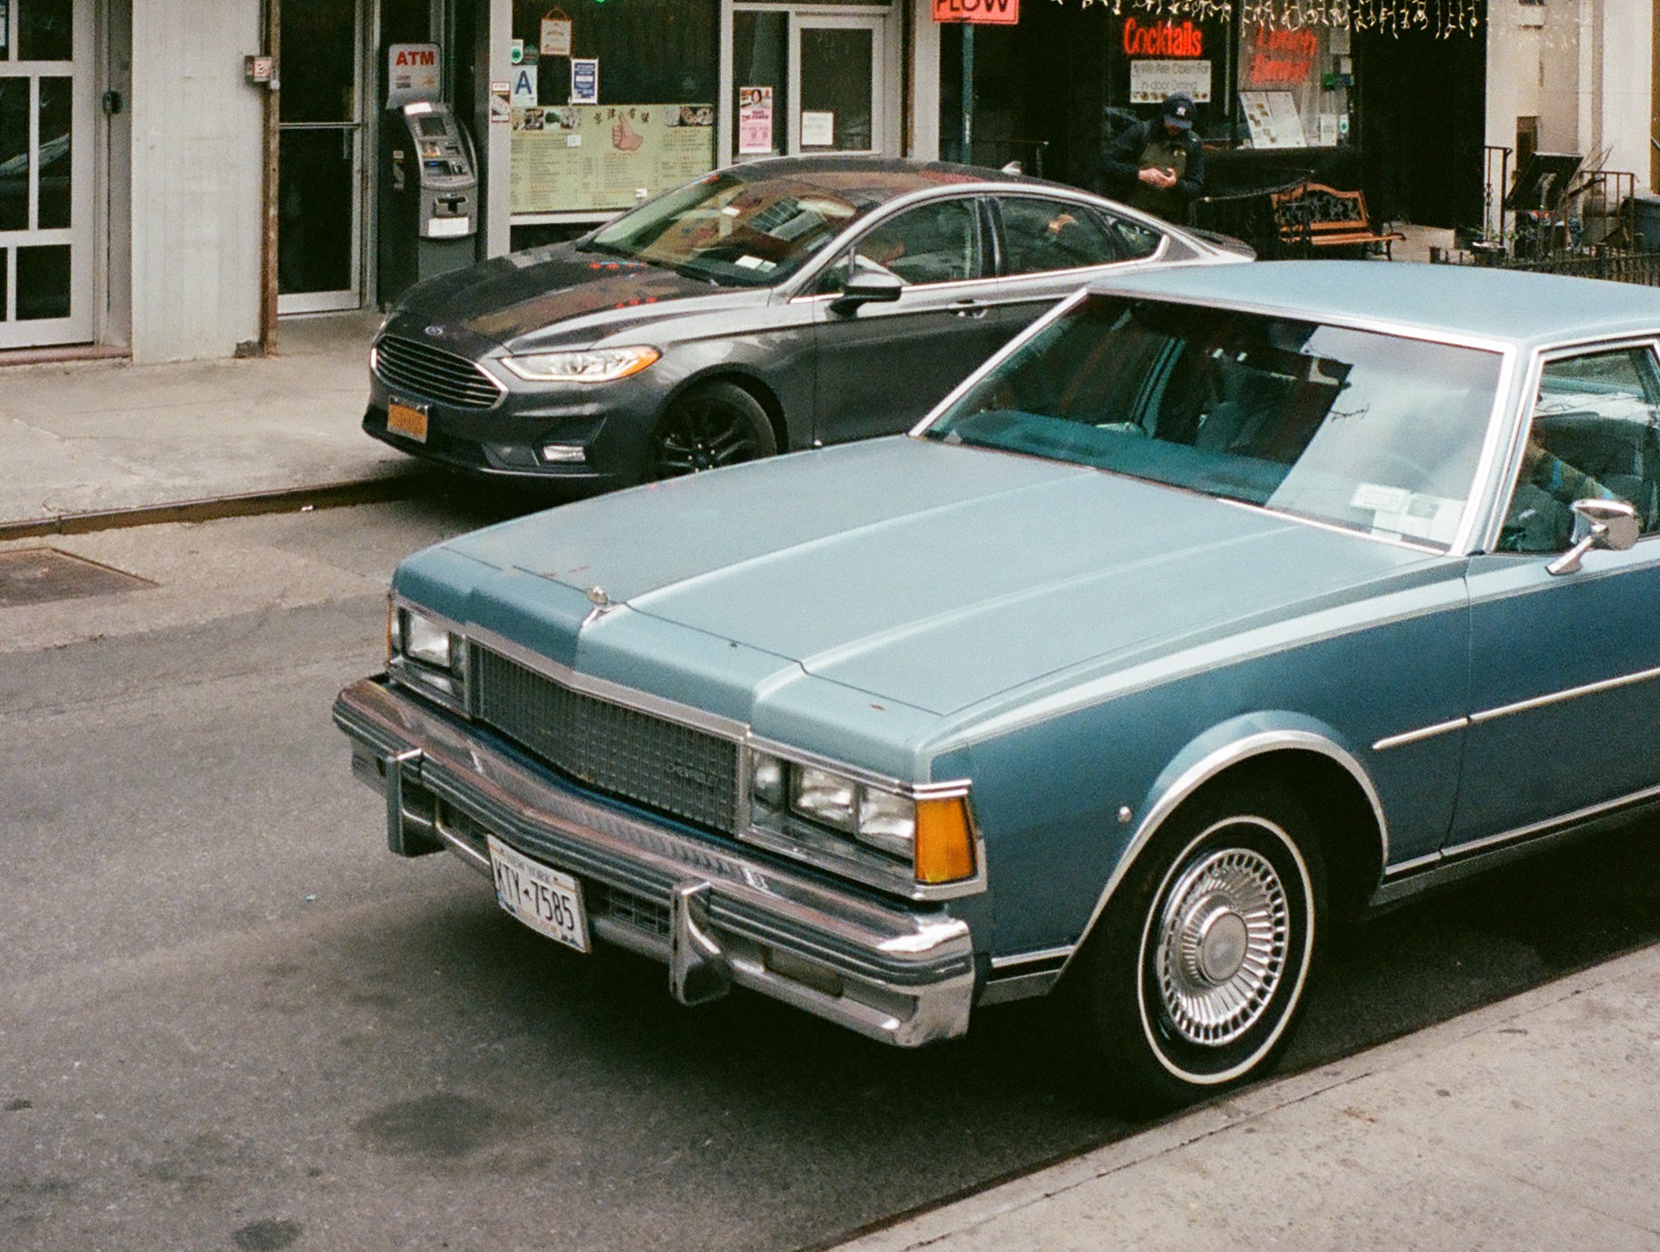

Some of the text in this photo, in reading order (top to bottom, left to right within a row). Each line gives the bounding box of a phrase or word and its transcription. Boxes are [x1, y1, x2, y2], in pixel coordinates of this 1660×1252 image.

[1124, 17, 1202, 56] Cocktails
[395, 51, 435, 66] ATM
[514, 70, 533, 95] A
